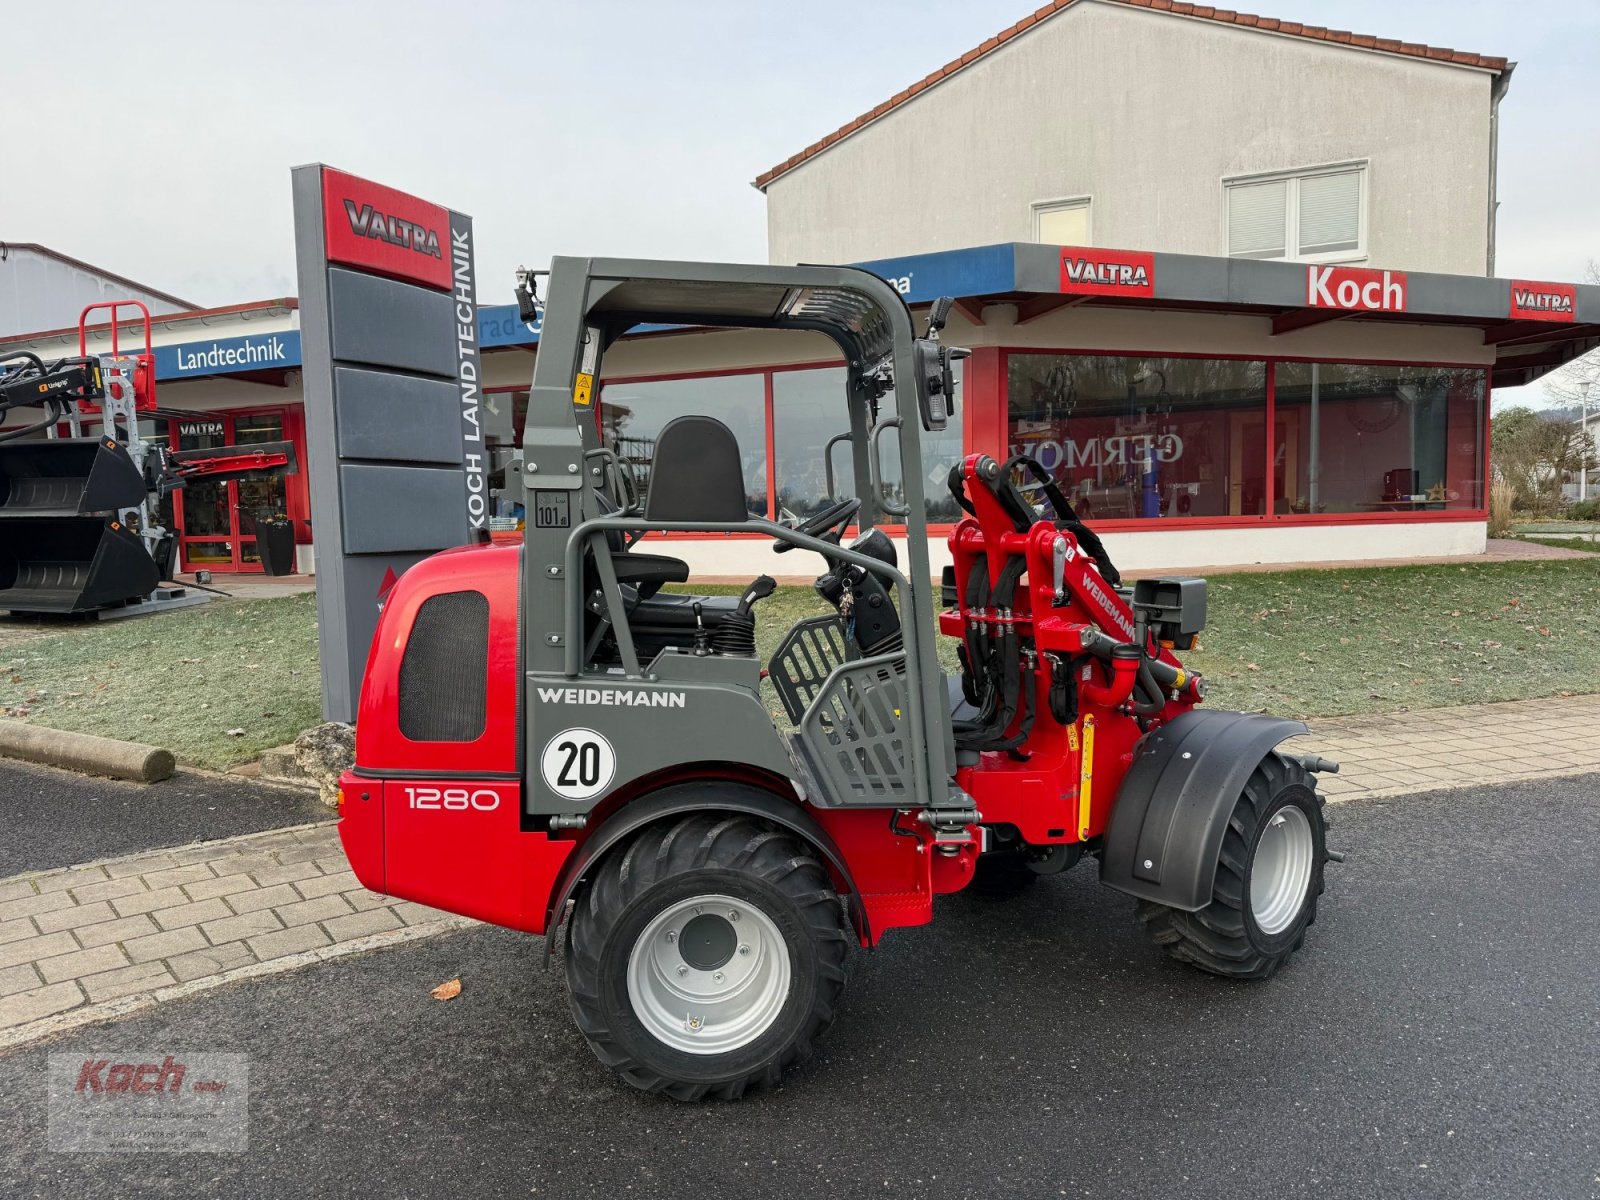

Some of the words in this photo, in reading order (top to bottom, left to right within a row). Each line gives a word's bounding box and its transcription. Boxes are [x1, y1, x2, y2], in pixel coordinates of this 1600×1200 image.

[343, 199, 442, 260] VALTRA
[1064, 258, 1149, 287] VALTRA
[1308, 266, 1404, 310] Koch
[1513, 288, 1574, 313] VALTRA
[452, 228, 481, 442] LANDTECHNIK
[177, 336, 286, 370] Landtechnik
[180, 423, 225, 436] VALTRA
[467, 454, 485, 530] KOCH
[538, 506, 558, 526] 101
[537, 687, 686, 708] WEIDEMANN
[556, 741, 601, 787] 20
[404, 788, 500, 811] 1280
